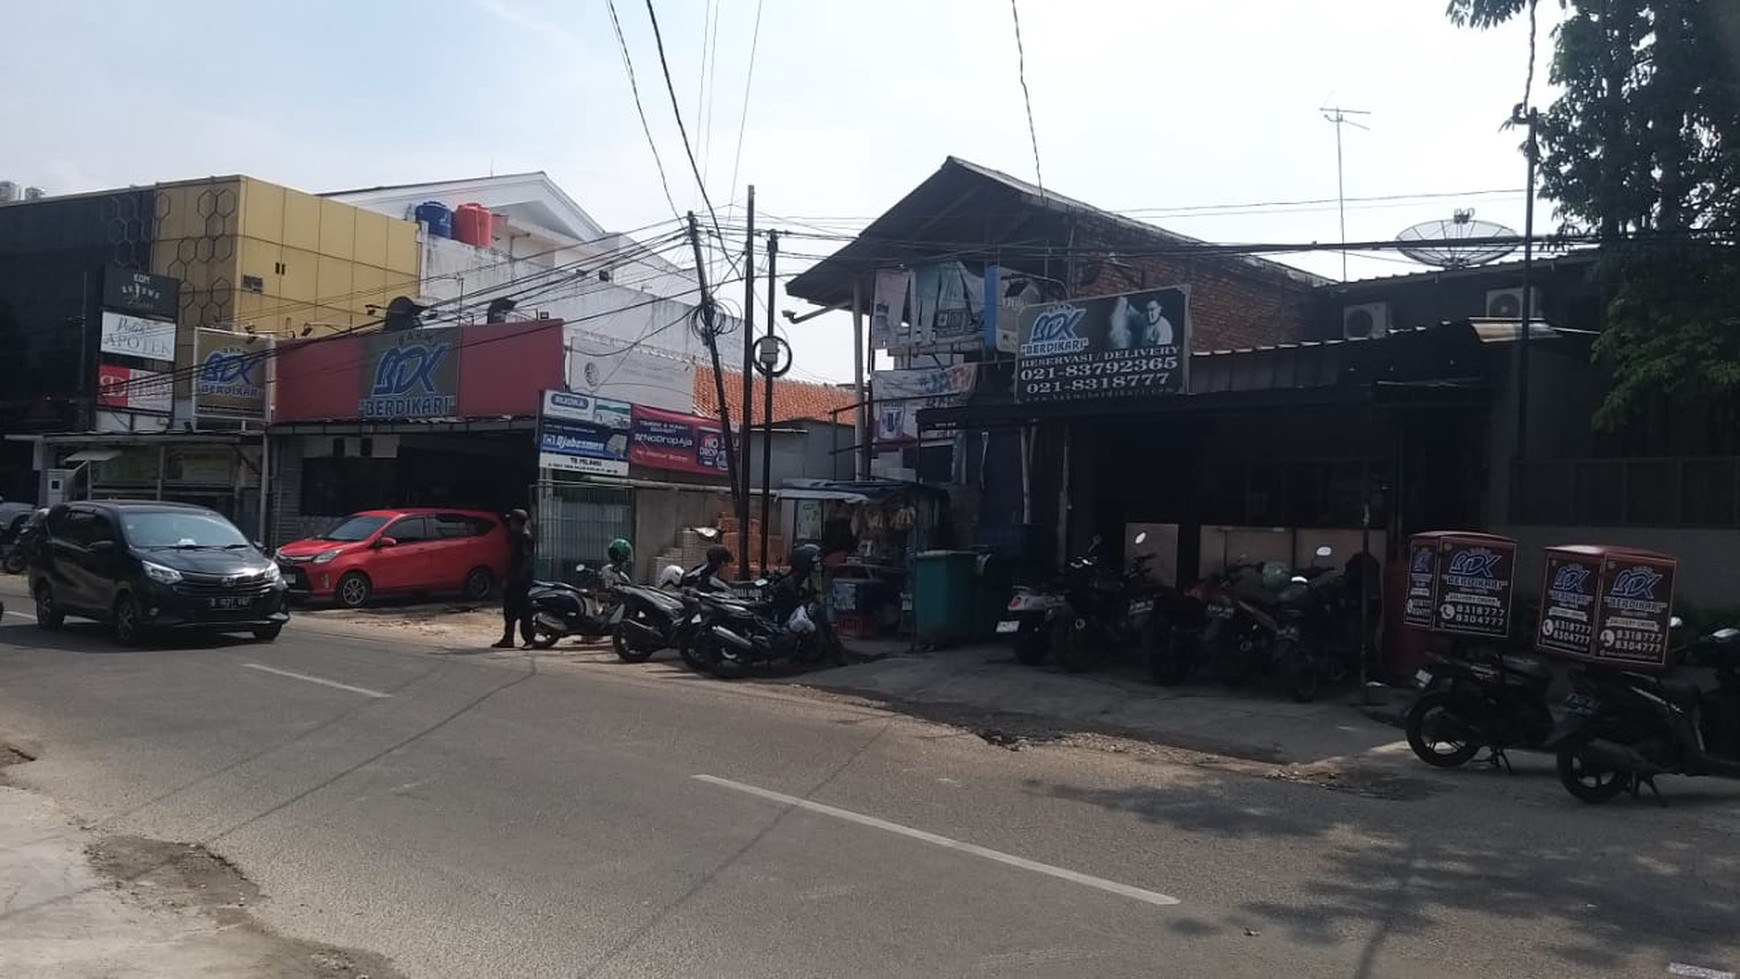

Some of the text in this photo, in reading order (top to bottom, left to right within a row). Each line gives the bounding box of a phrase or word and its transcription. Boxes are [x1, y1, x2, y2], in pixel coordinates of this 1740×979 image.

[1021, 353, 1093, 367] RESERVASI
[1104, 346, 1180, 360] DELIVERY
[1020, 357, 1178, 381] 021-83792365
[1026, 373, 1171, 393] 021-8318777
[1456, 604, 1505, 616] 8318777
[1456, 614, 1504, 627] 8304777
